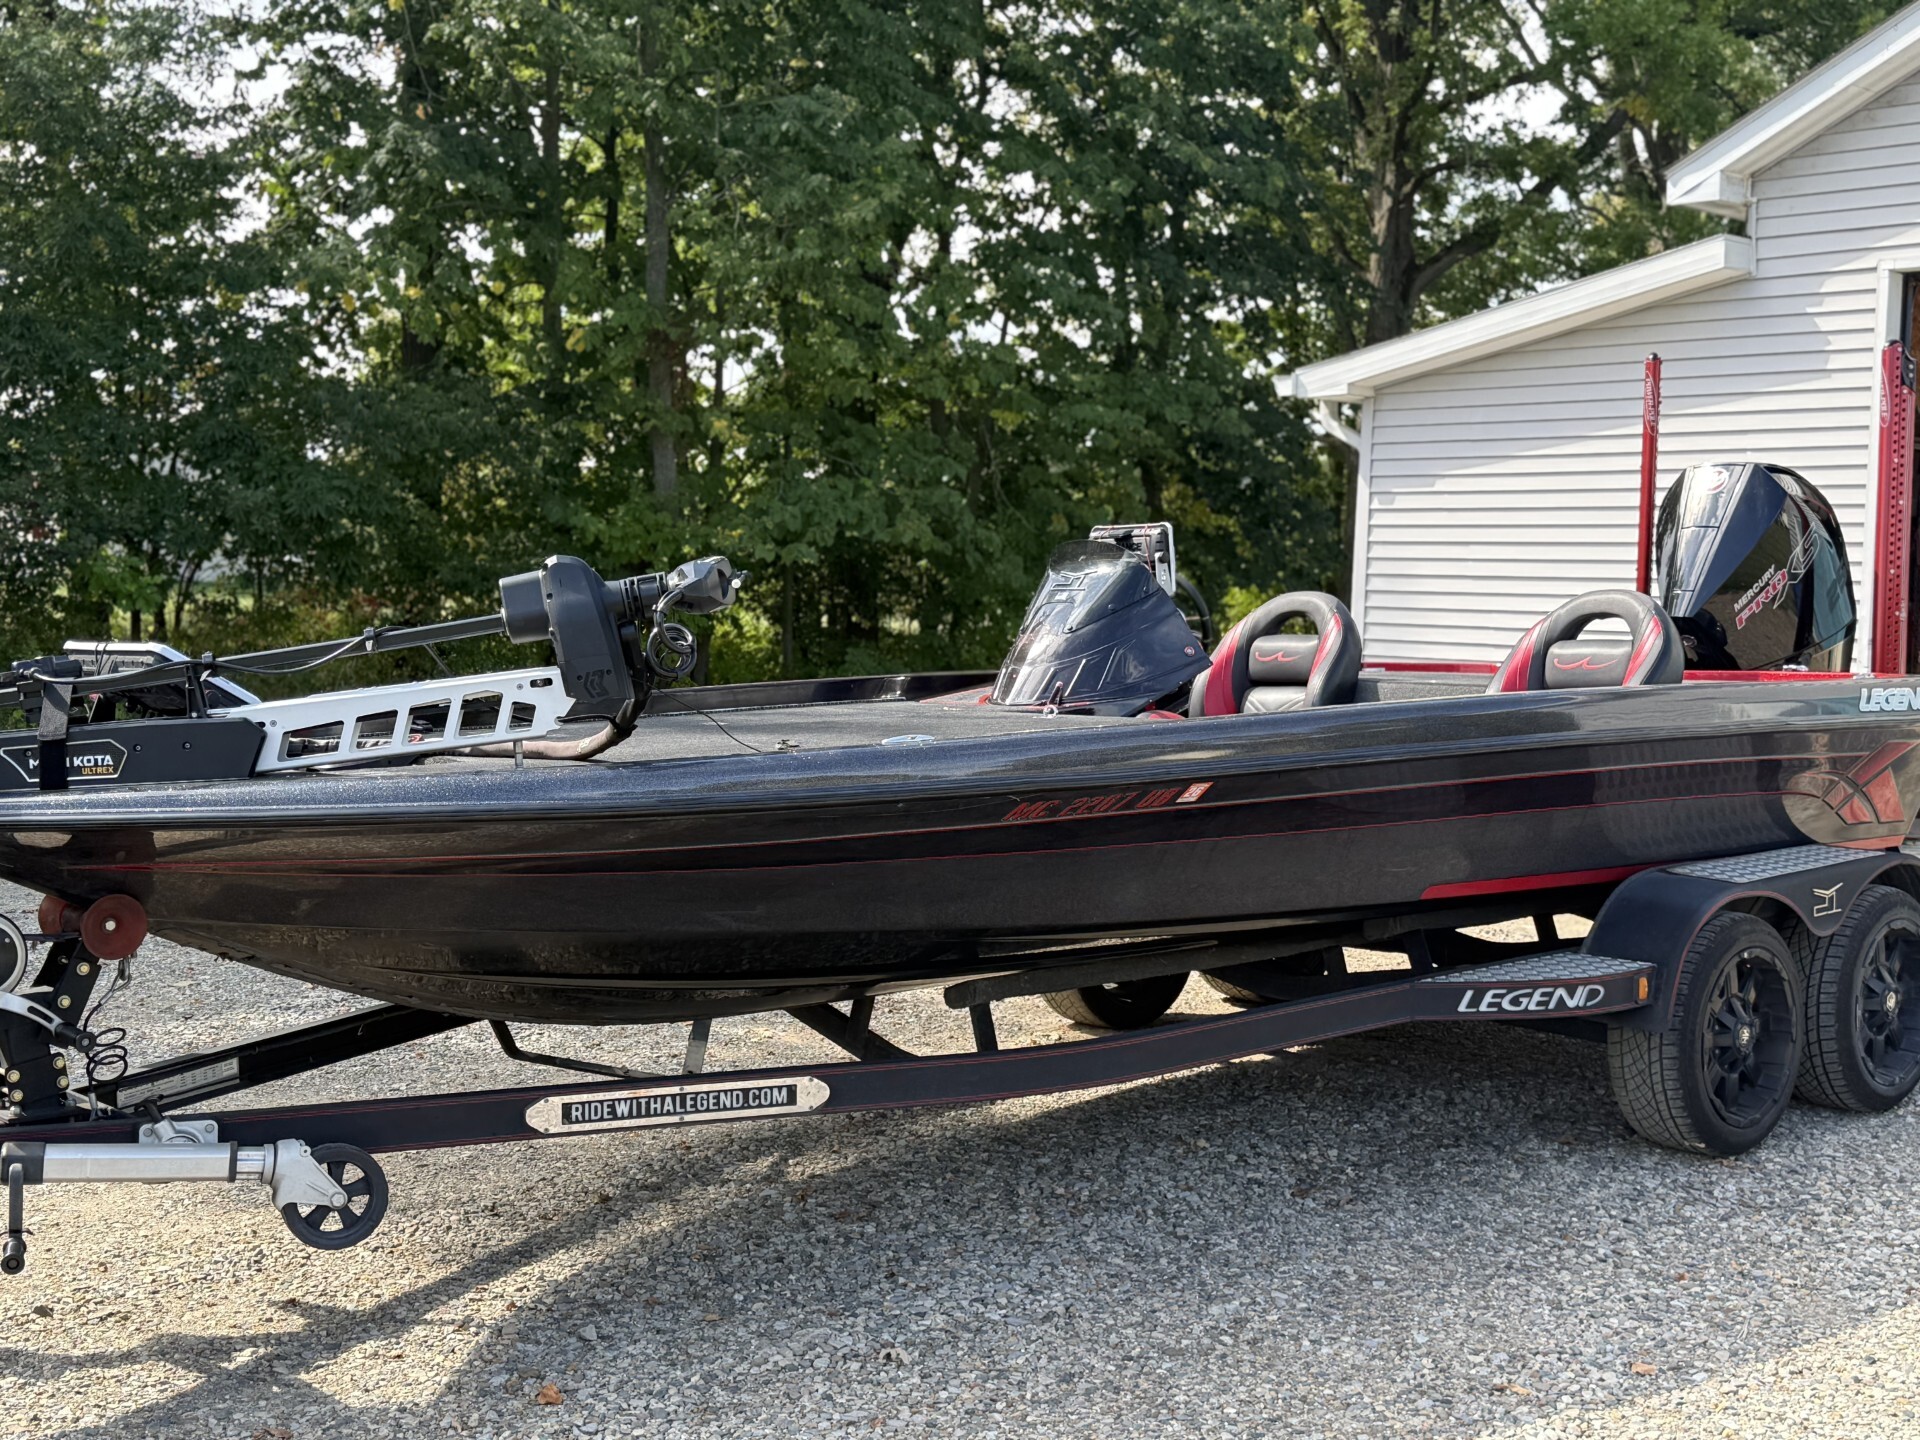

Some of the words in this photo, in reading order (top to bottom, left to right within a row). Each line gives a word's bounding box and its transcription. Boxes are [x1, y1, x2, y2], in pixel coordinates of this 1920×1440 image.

[1733, 564, 1775, 612] MERCURY
[1736, 568, 1788, 630] PRO
[73, 755, 114, 767] KOTA
[81, 766, 114, 775] ULTREX
[1001, 800, 1061, 822] MC
[1457, 984, 1605, 1012] LEGEND
[570, 1086, 788, 1122] RIDEWITHALEGEND.COM
